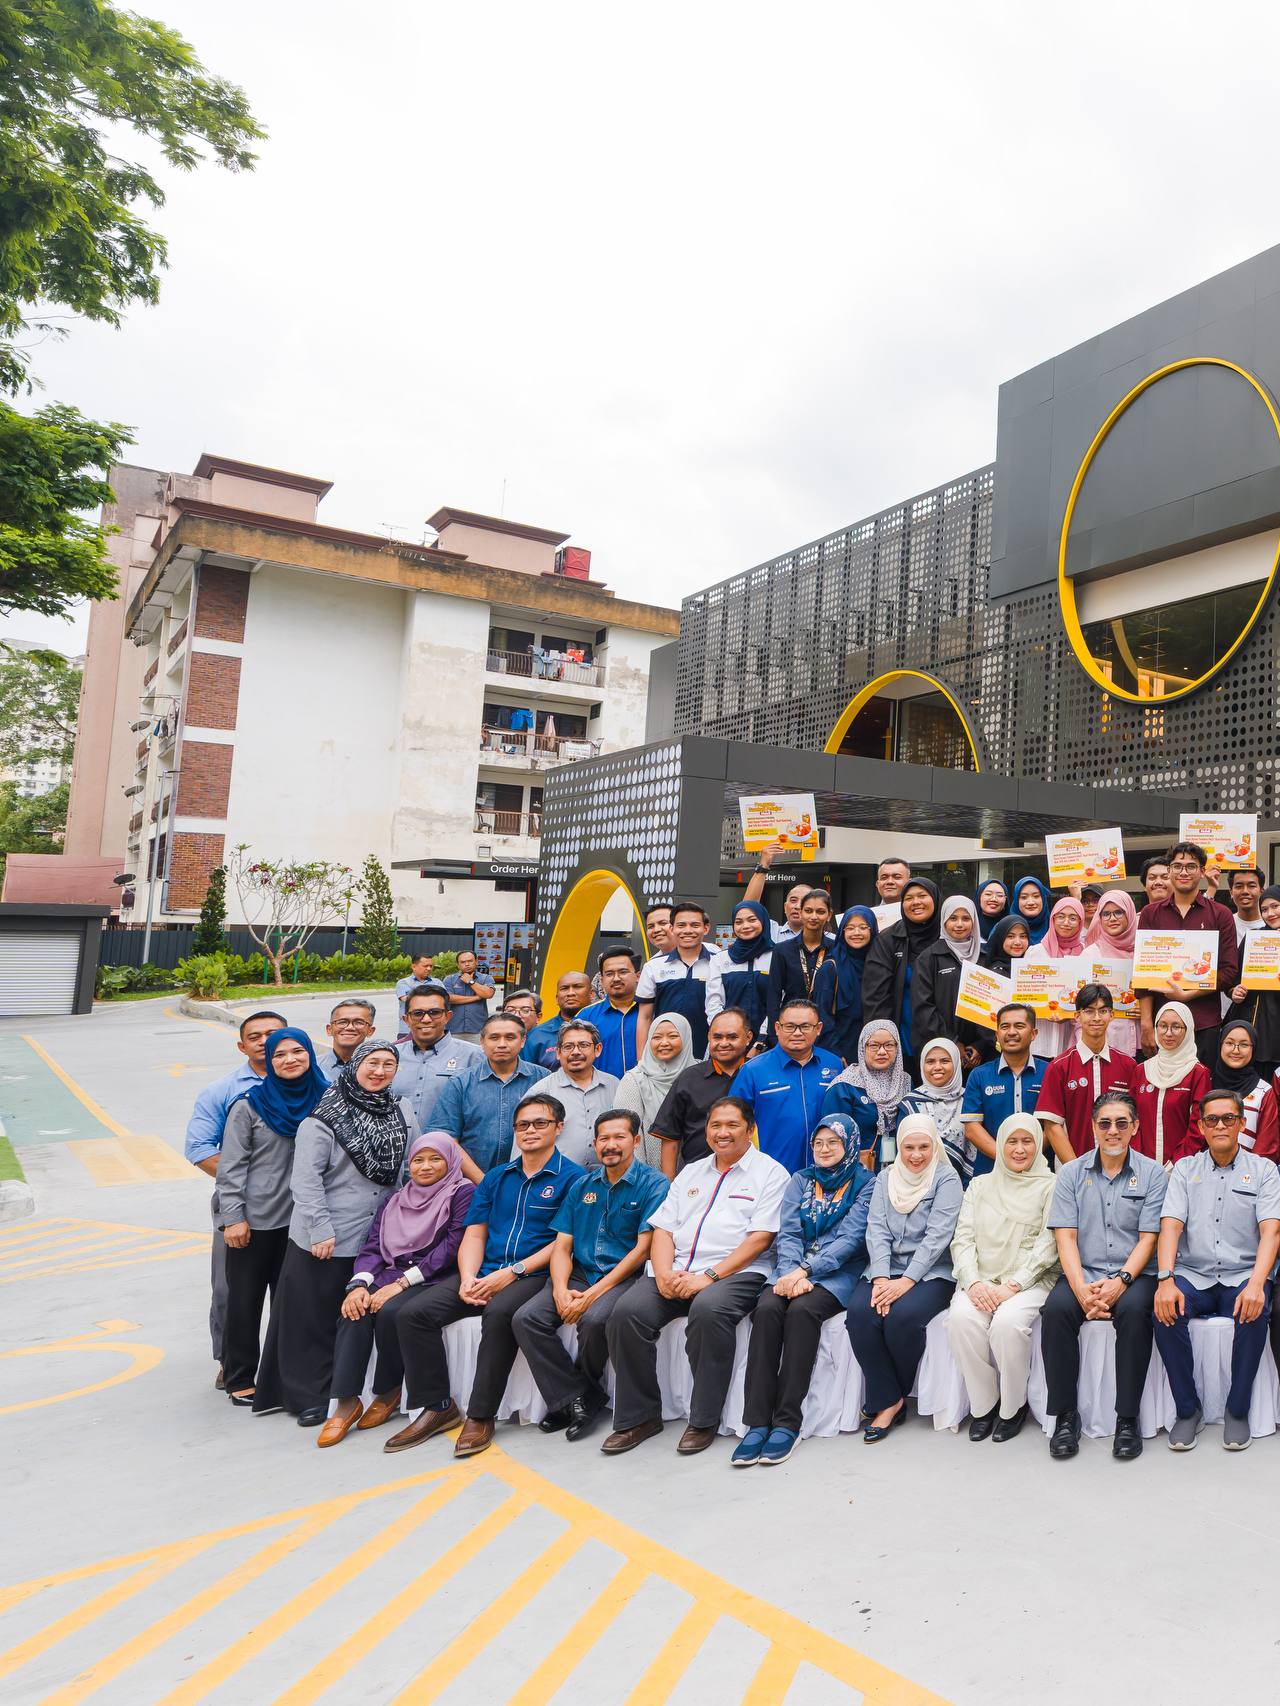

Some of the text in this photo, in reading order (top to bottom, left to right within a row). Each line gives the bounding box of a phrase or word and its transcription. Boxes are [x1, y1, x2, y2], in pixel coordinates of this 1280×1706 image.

[490, 864, 539, 874] Order Her
[777, 874, 796, 882] Here
